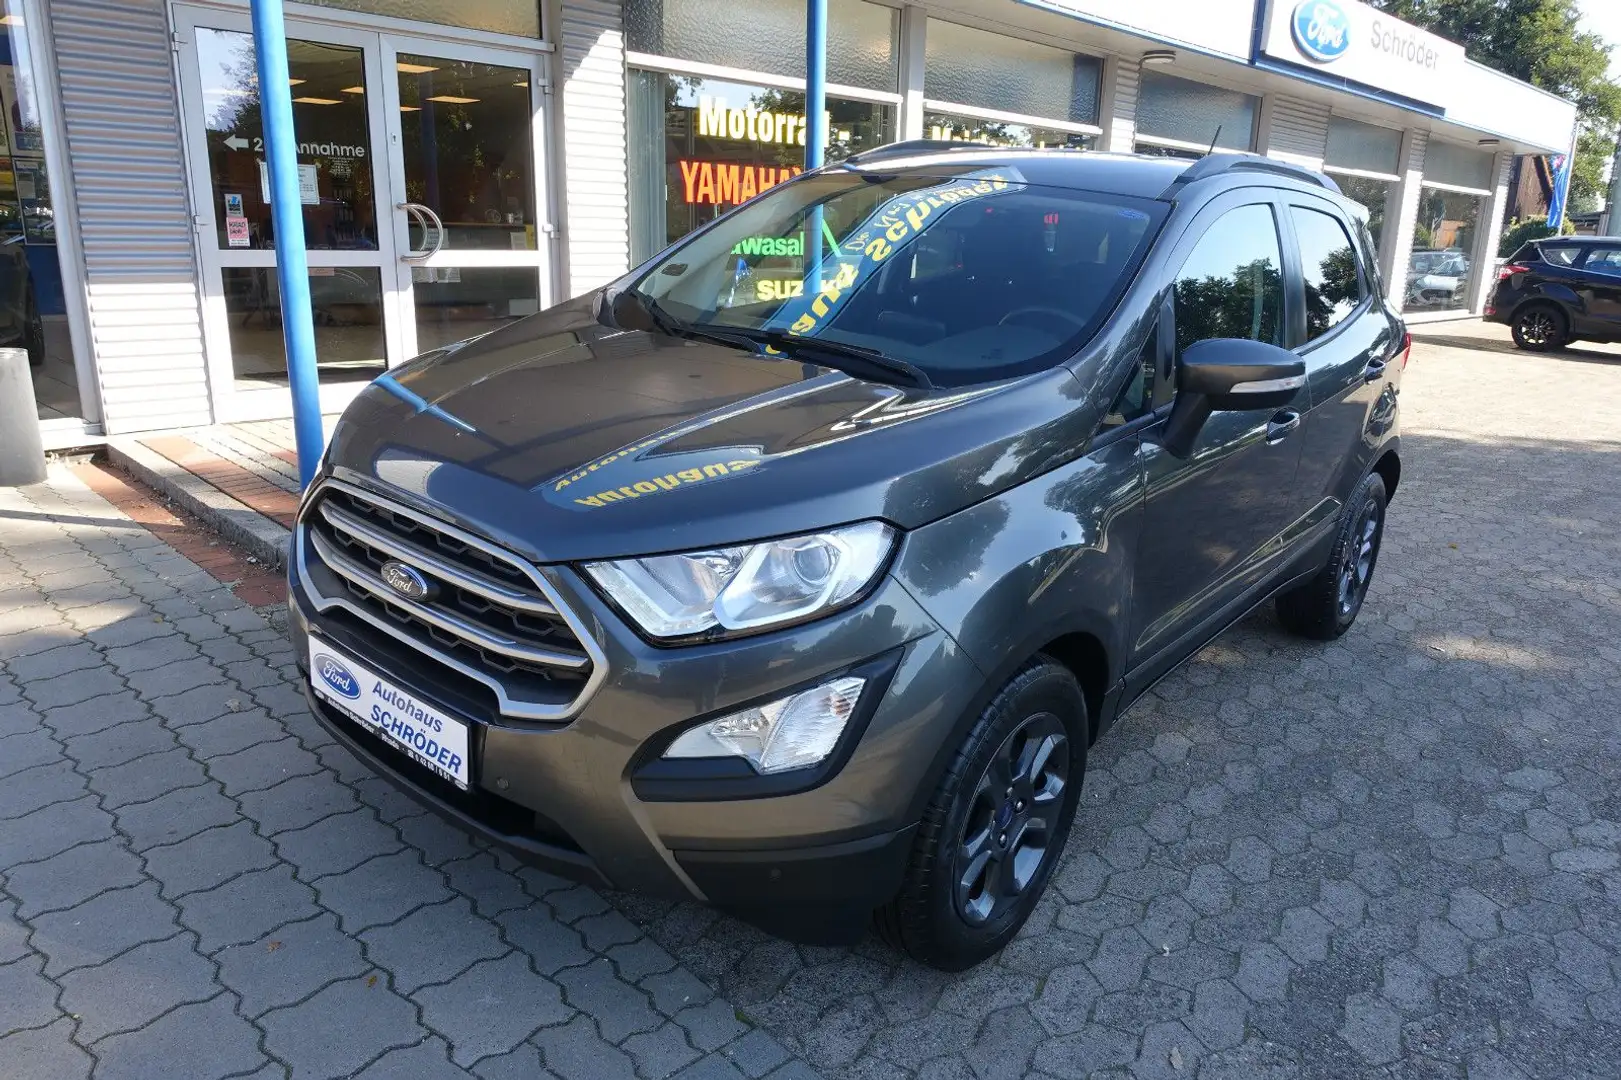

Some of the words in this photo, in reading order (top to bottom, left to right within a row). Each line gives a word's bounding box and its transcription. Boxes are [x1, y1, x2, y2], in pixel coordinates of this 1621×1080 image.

[1371, 20, 1440, 71] Schröder
[388, 568, 413, 593] Ford
[323, 660, 351, 692] Ford
[372, 681, 443, 733] Autohaus
[370, 704, 462, 774] SCHRÖDER
